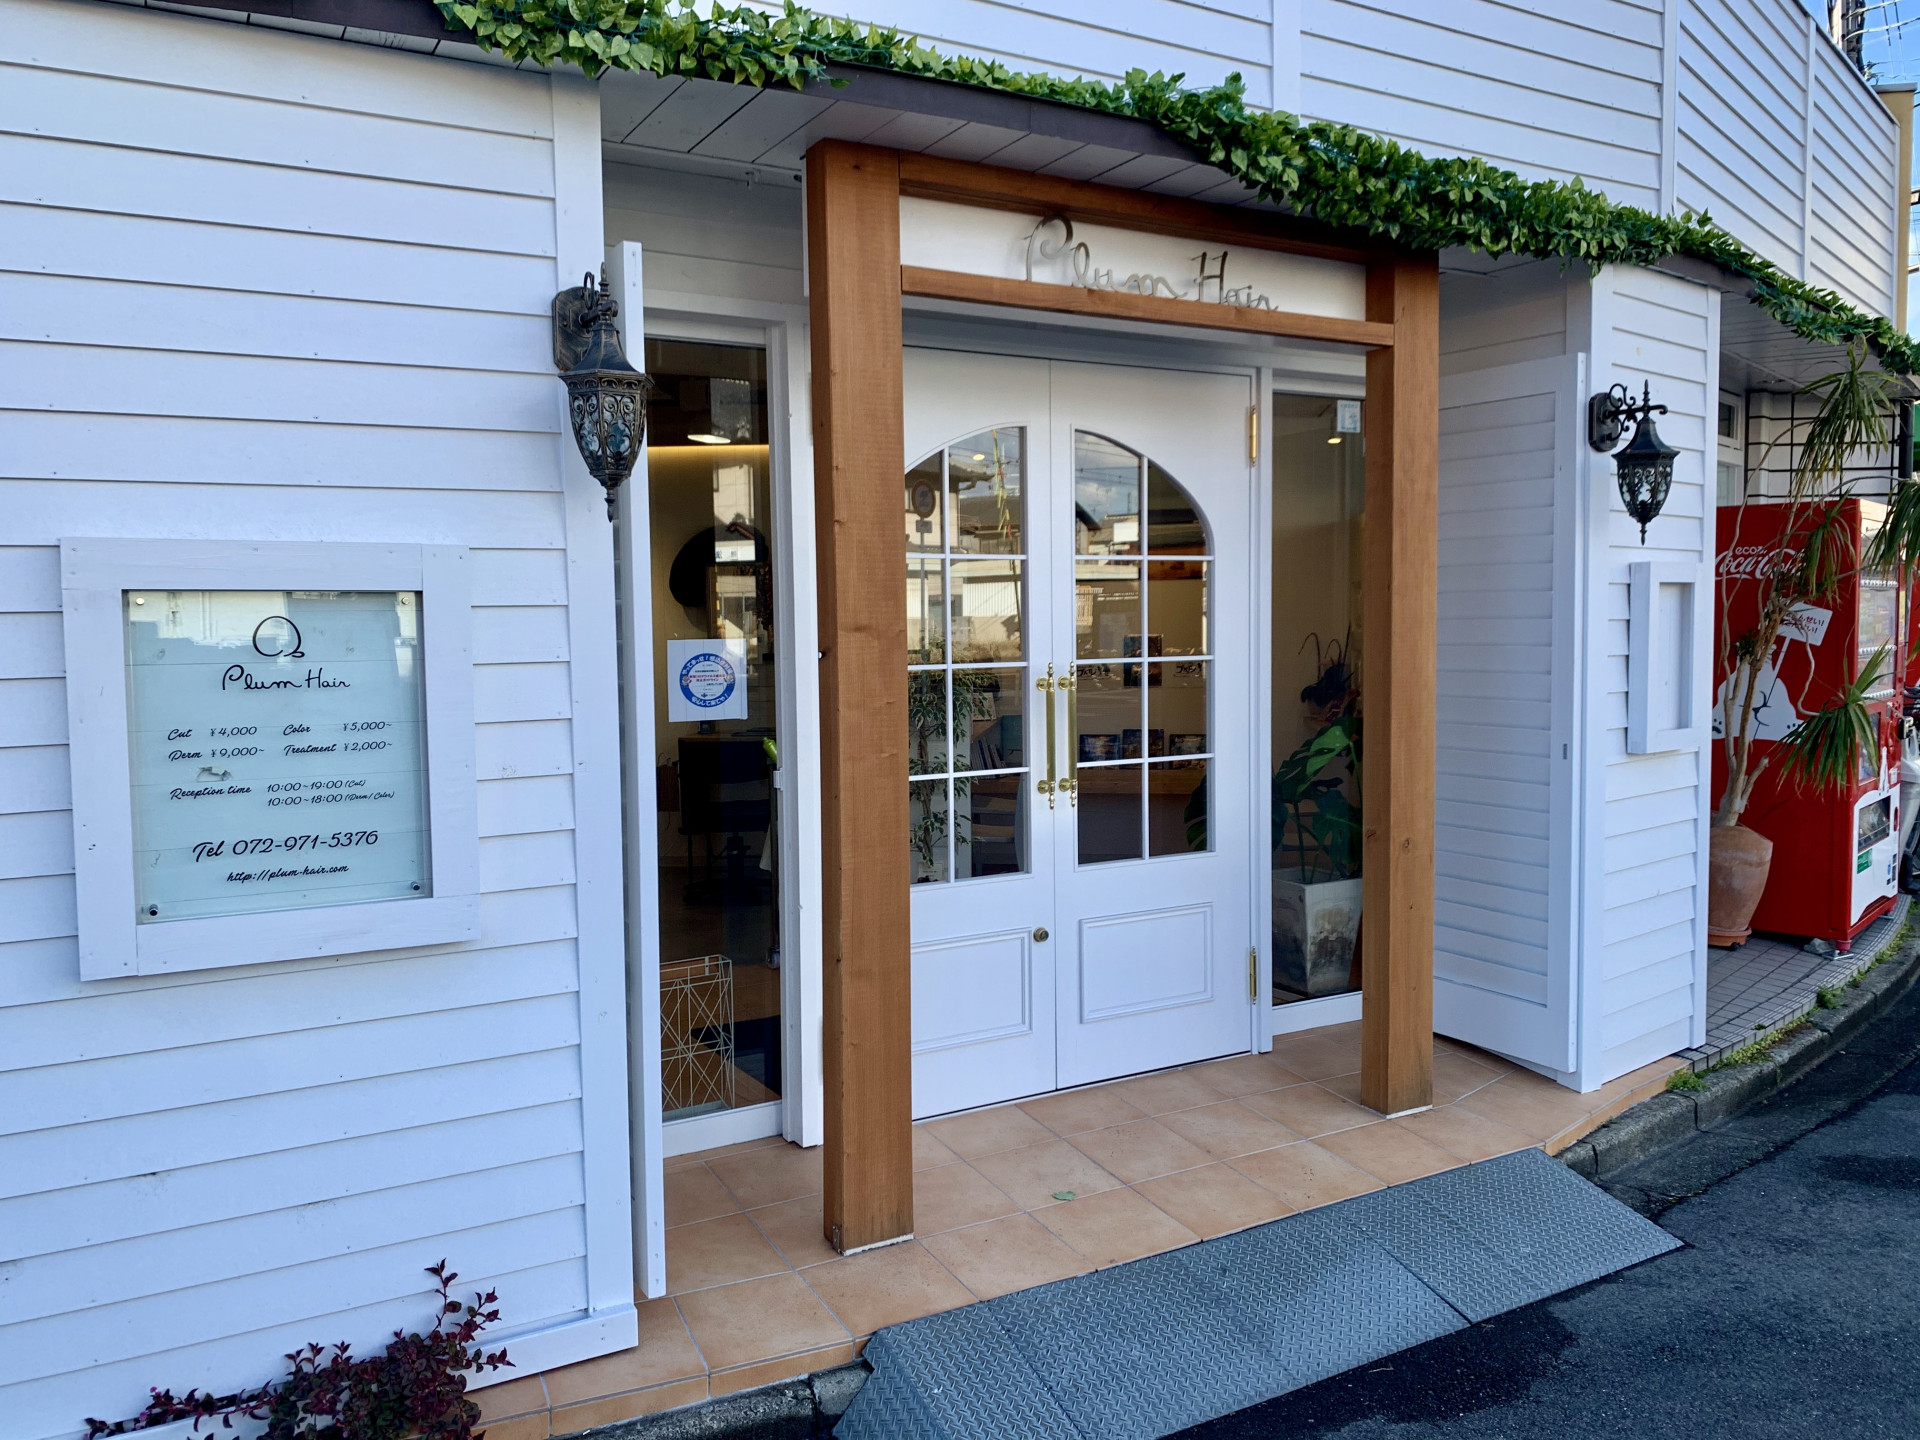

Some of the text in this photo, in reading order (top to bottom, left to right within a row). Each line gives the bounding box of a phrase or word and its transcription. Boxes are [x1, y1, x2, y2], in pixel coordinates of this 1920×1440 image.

[1025, 213, 1280, 312] Plum Hair
[222, 664, 350, 691] Plum Hair
[167, 728, 193, 741] Cut
[283, 723, 311, 736] Color
[168, 749, 203, 762] Perm
[283, 743, 337, 757] Treatment
[170, 787, 225, 800] Reception
[227, 785, 252, 794] time
[192, 830, 378, 863] Tel 072-971-5376
[227, 865, 350, 884] http://plum-hair.com
